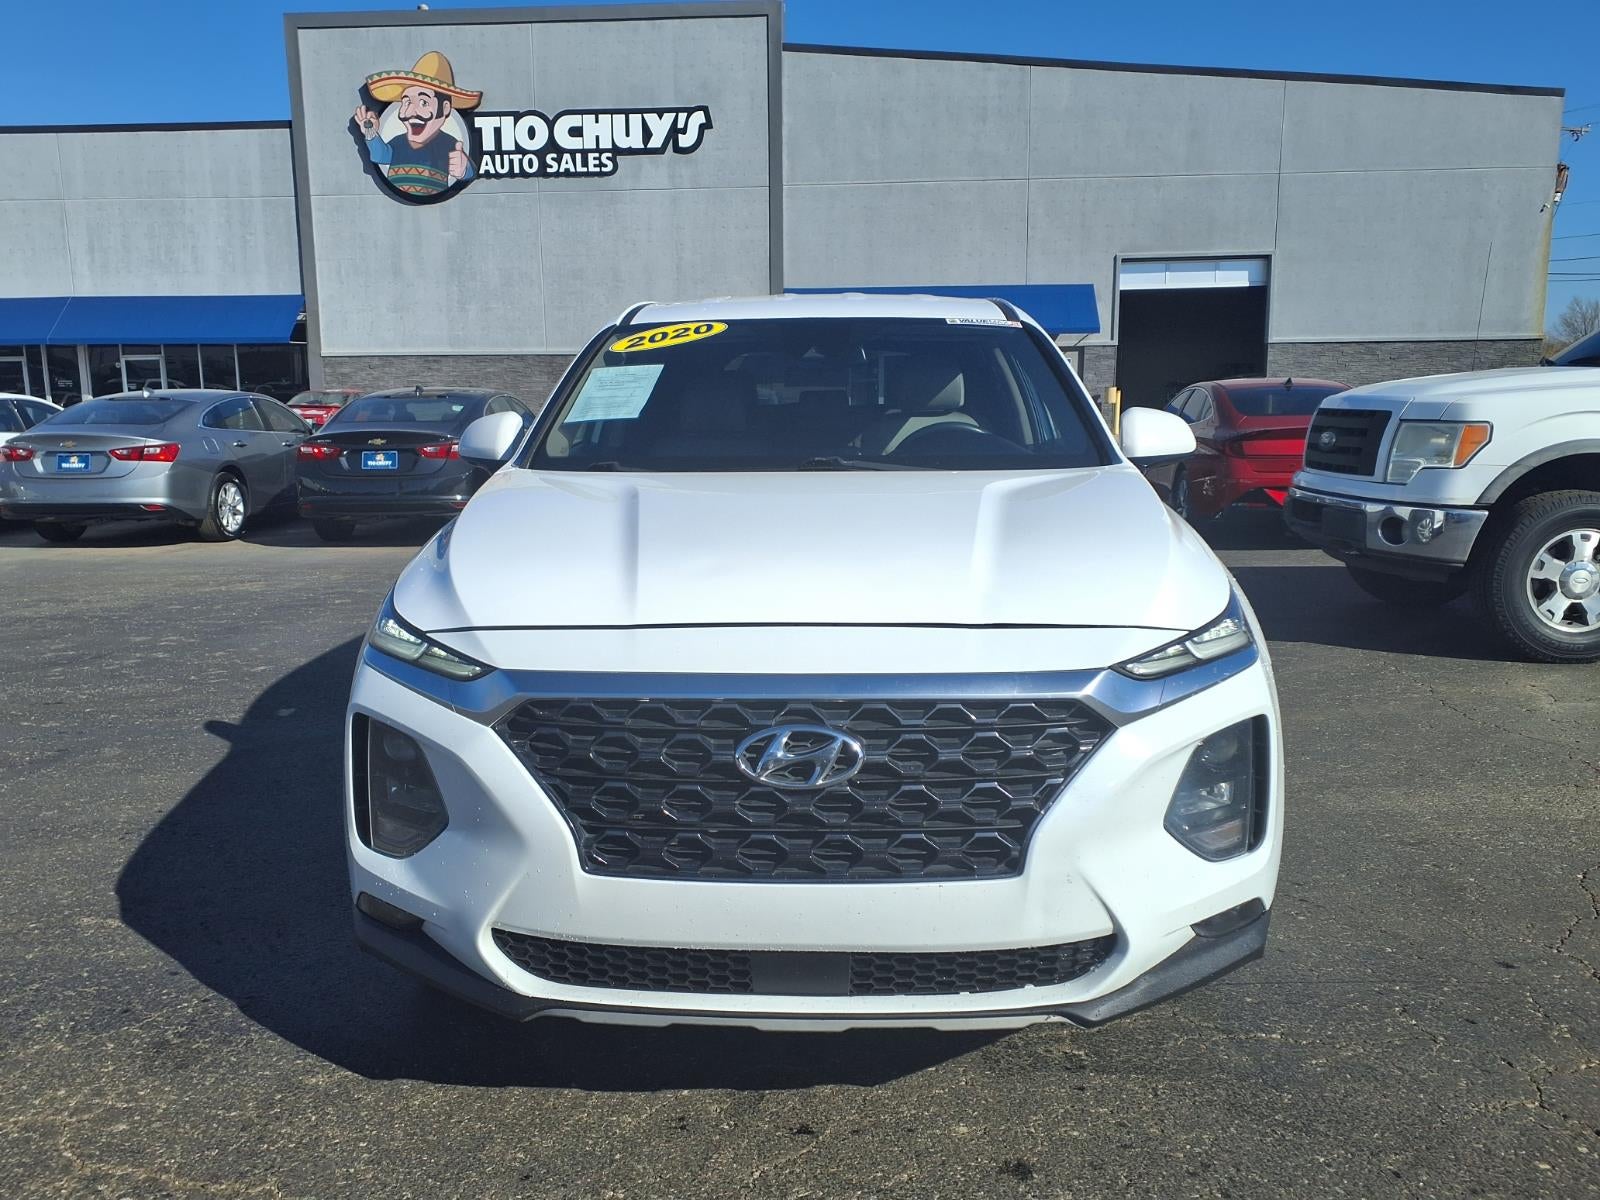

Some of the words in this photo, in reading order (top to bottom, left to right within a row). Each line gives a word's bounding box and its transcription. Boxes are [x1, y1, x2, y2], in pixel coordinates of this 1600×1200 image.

[474, 115, 549, 151] TIO
[553, 110, 707, 150] CHUY'S
[479, 153, 539, 174] AUTO
[546, 152, 614, 173] SALES
[624, 323, 715, 350] 2020
